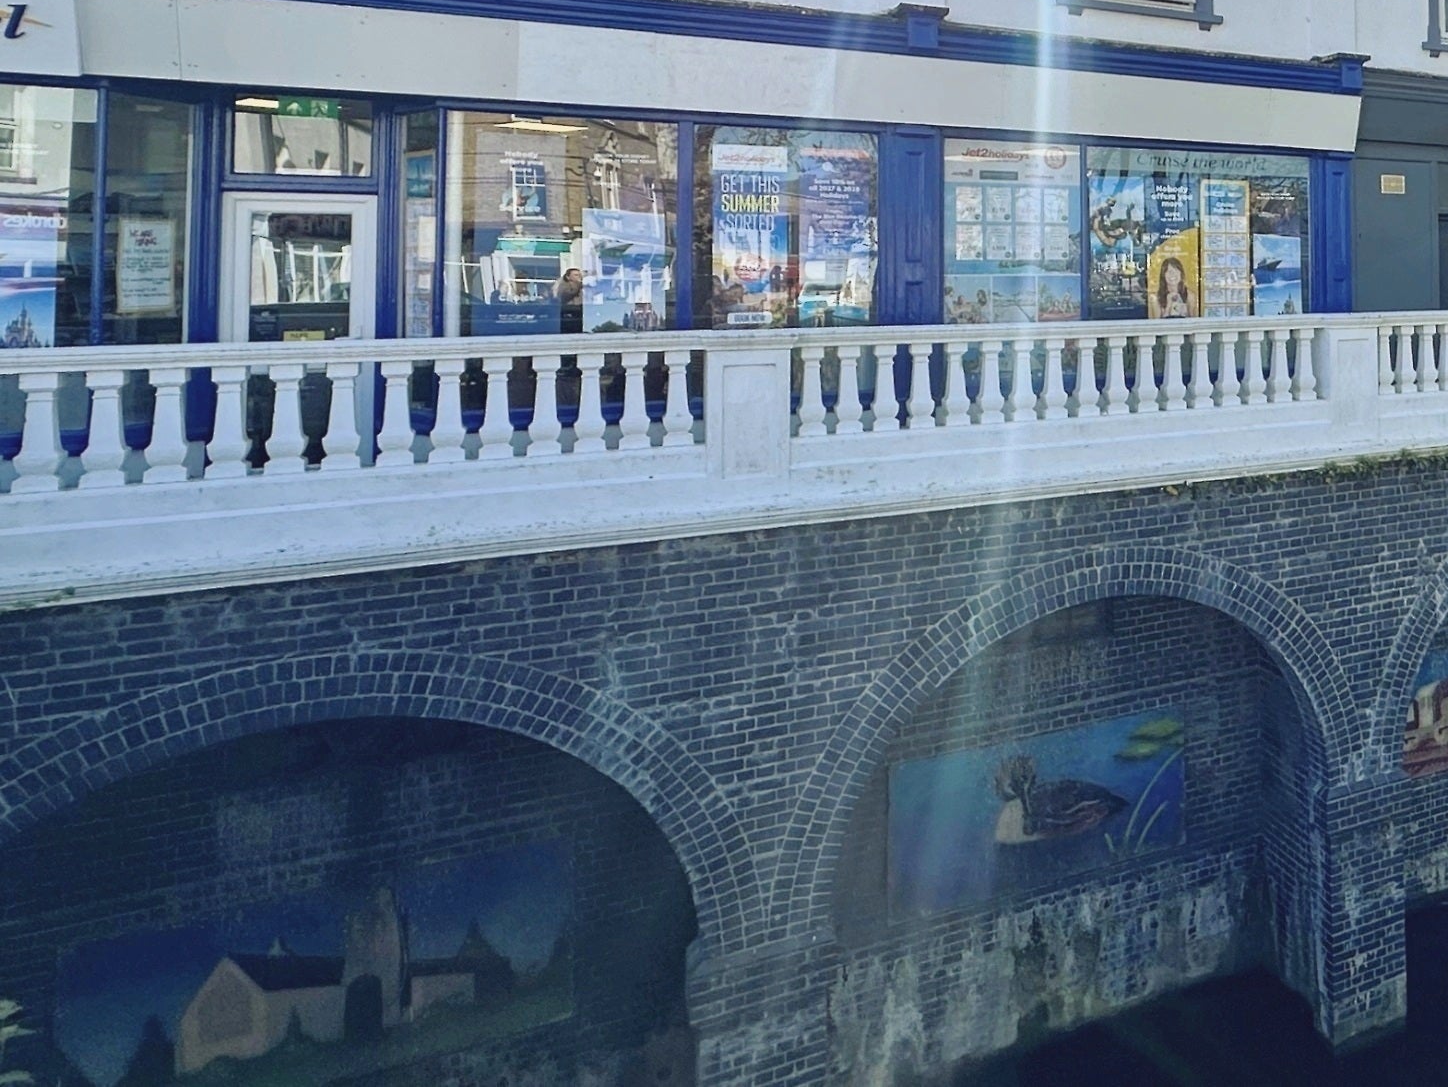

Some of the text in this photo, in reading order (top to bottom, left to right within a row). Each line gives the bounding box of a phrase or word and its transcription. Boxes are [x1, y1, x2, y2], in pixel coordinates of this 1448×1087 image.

[961, 147, 1030, 162] Jet2holidays
[720, 173, 780, 194] GET THIS
[1155, 184, 1188, 193] Nobody
[720, 193, 780, 213] SUMMER
[725, 213, 775, 233] SORTED
